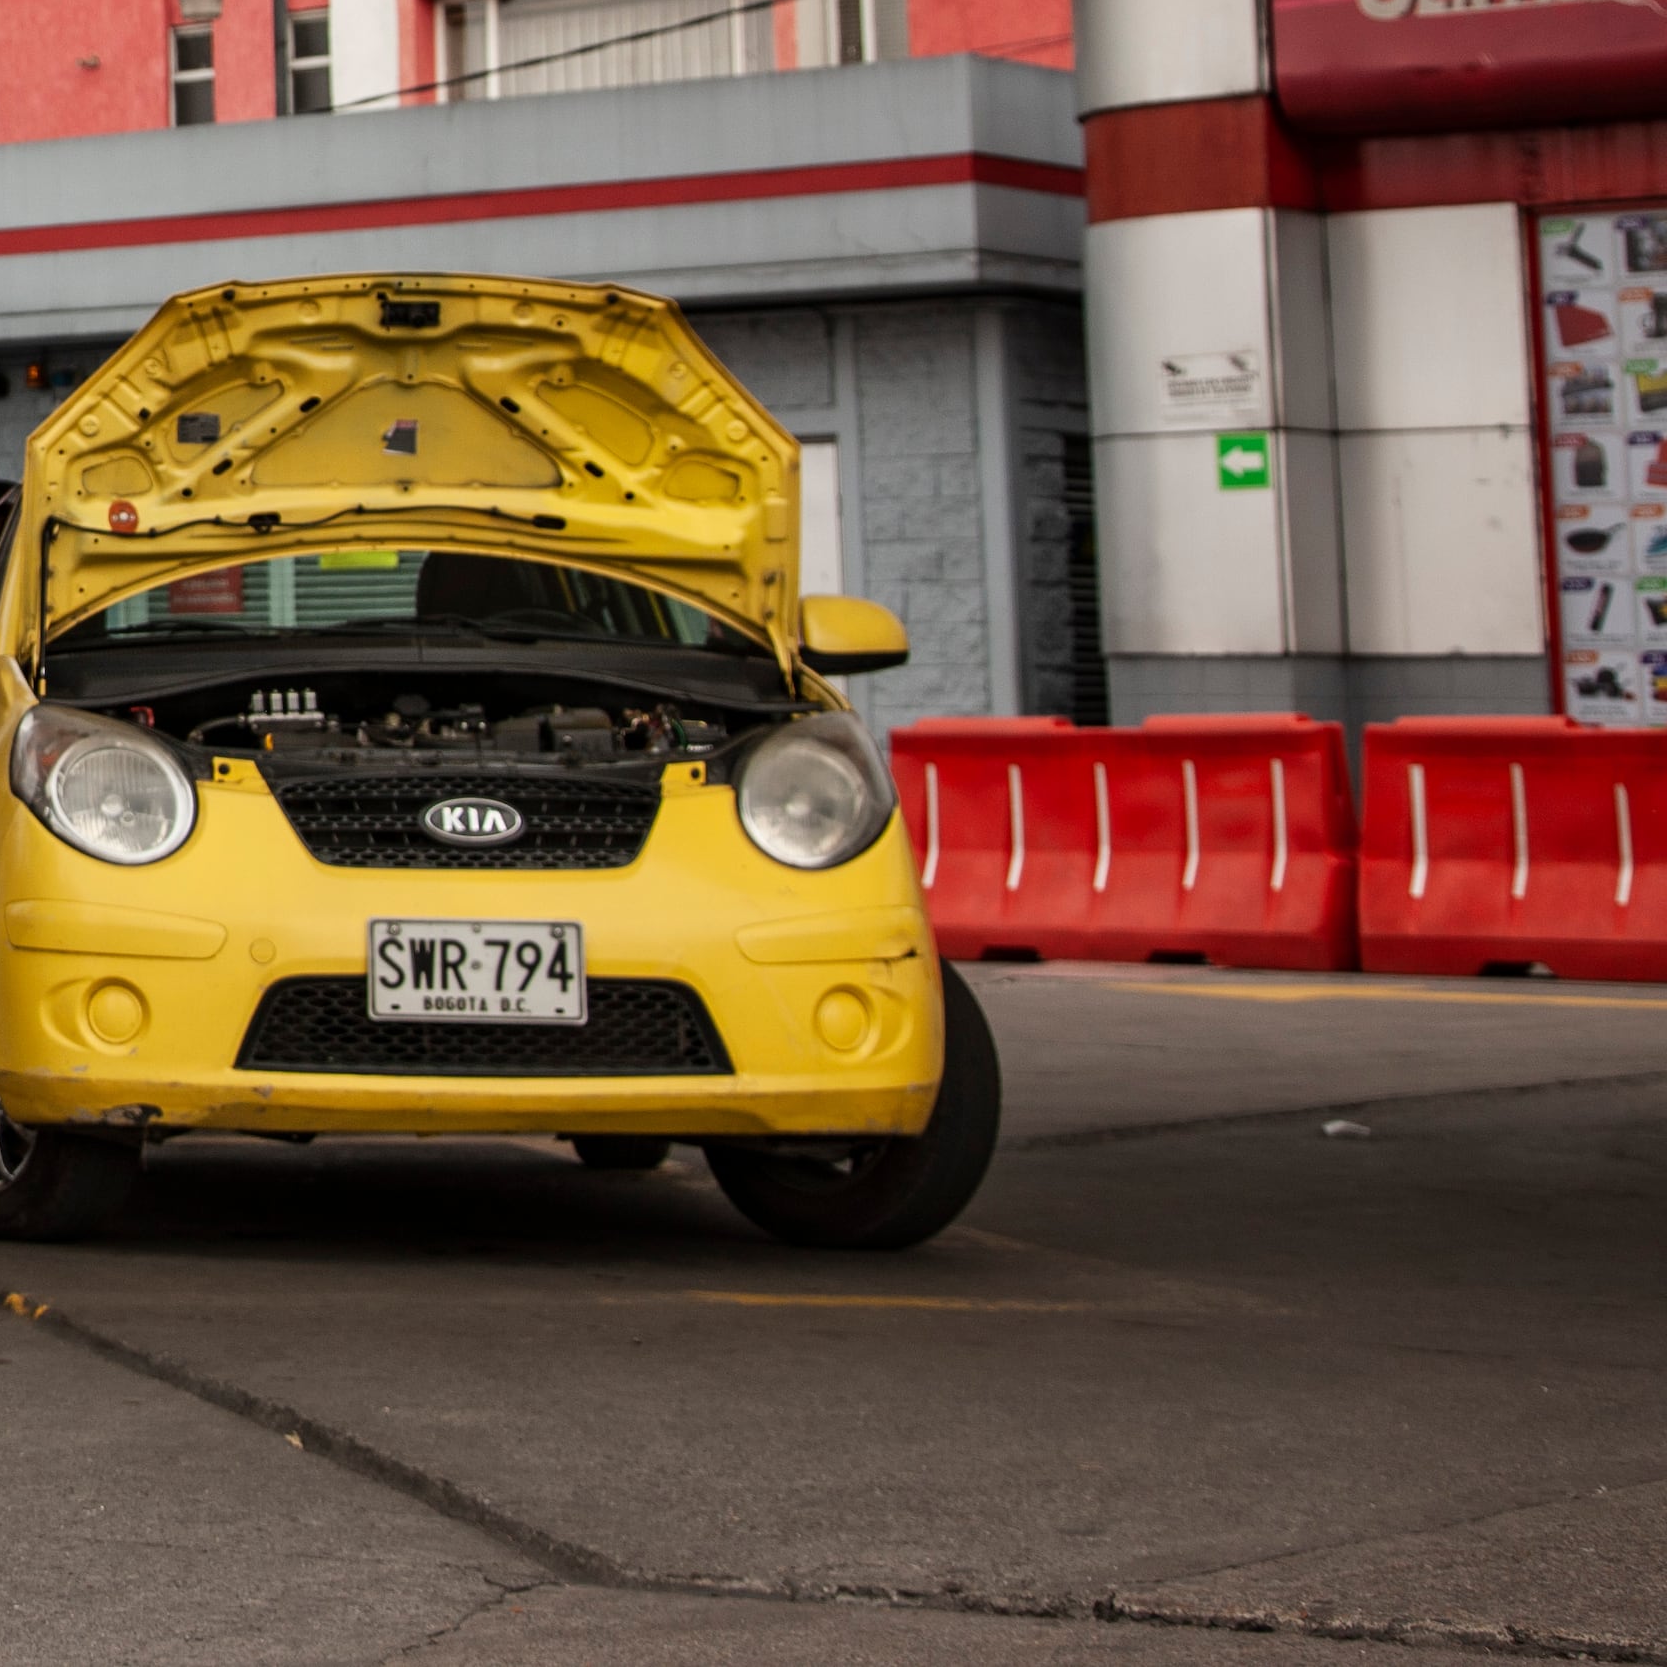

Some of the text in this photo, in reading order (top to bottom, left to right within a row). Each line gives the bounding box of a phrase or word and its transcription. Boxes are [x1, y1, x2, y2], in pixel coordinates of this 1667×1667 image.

[441, 806, 508, 832] KIA
[378, 937, 575, 993] SWR 794
[423, 995, 489, 1013] BOGOTA
